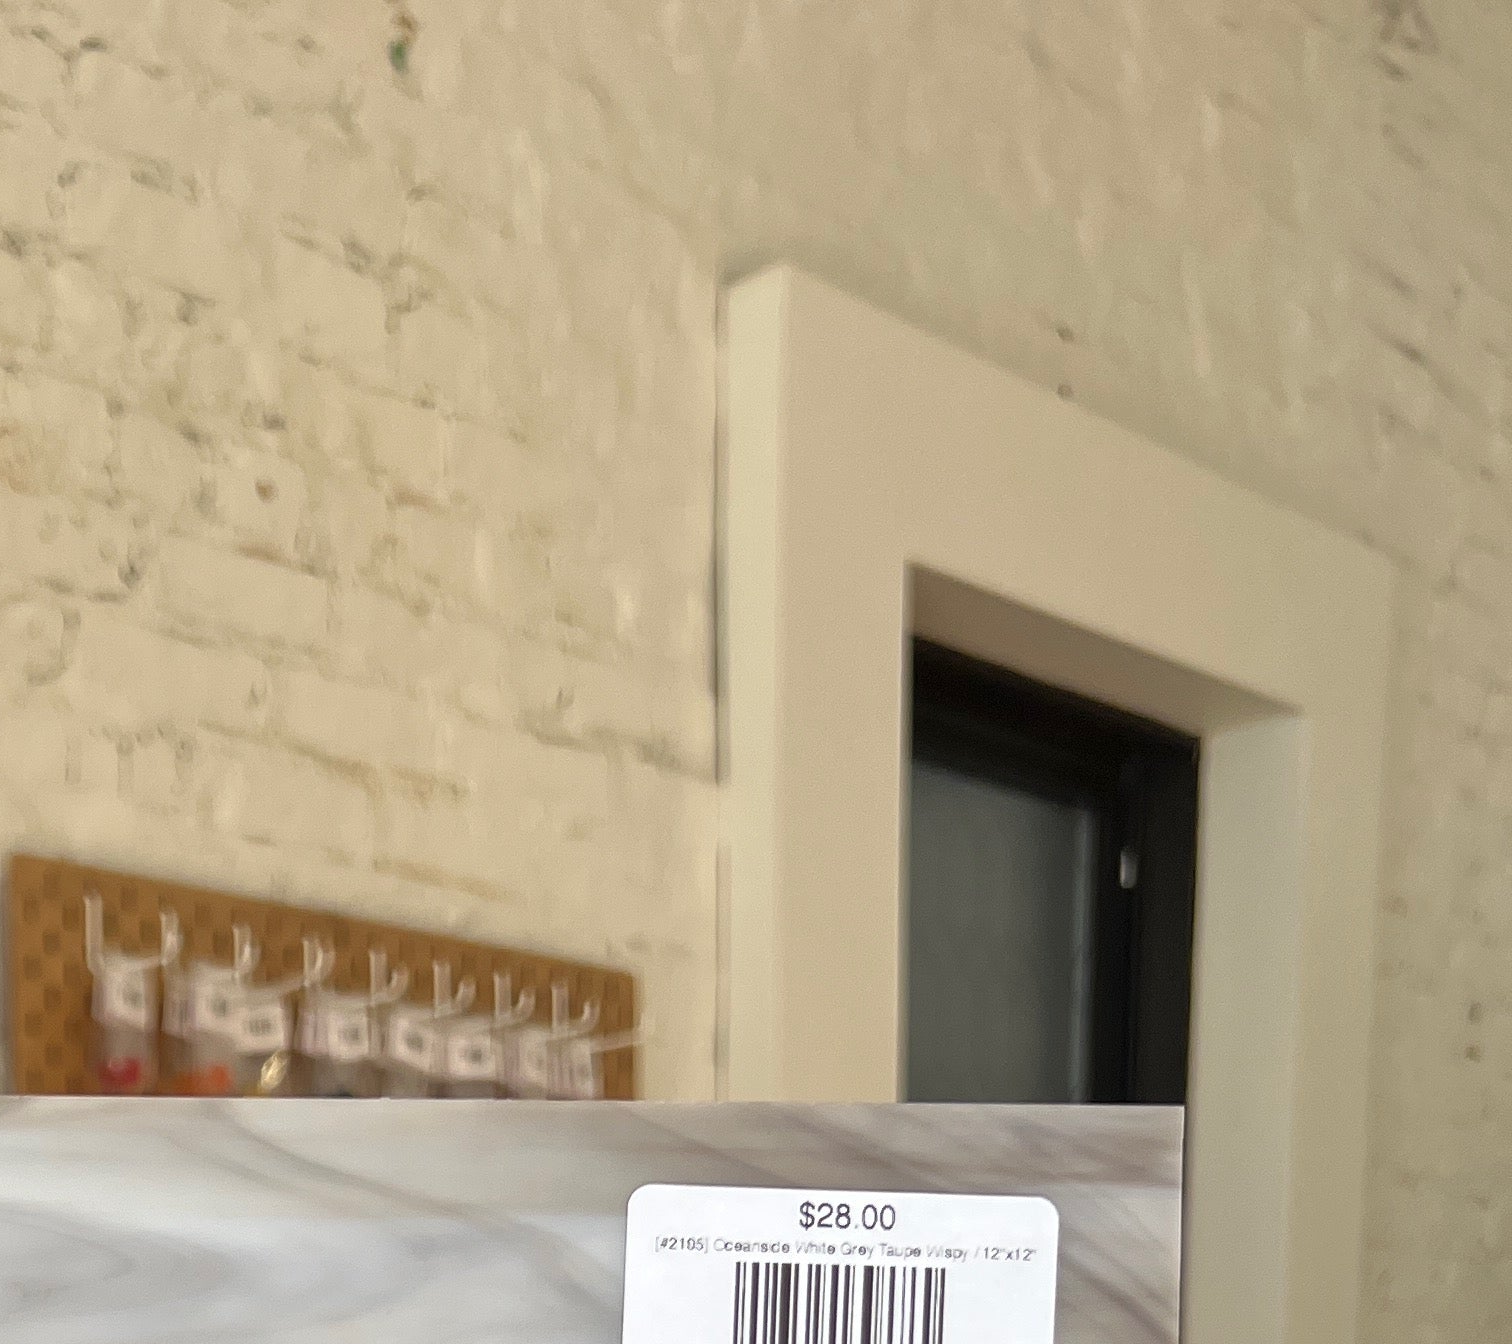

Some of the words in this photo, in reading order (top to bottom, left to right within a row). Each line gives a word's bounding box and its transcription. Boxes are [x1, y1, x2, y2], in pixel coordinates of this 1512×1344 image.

[799, 1201, 896, 1231] $28.00
[655, 1236, 709, 1254] [#2105]
[795, 1240, 836, 1255] White
[840, 1241, 874, 1260] Grey
[879, 1243, 922, 1261] Taupe
[926, 1244, 969, 1263] Wispy
